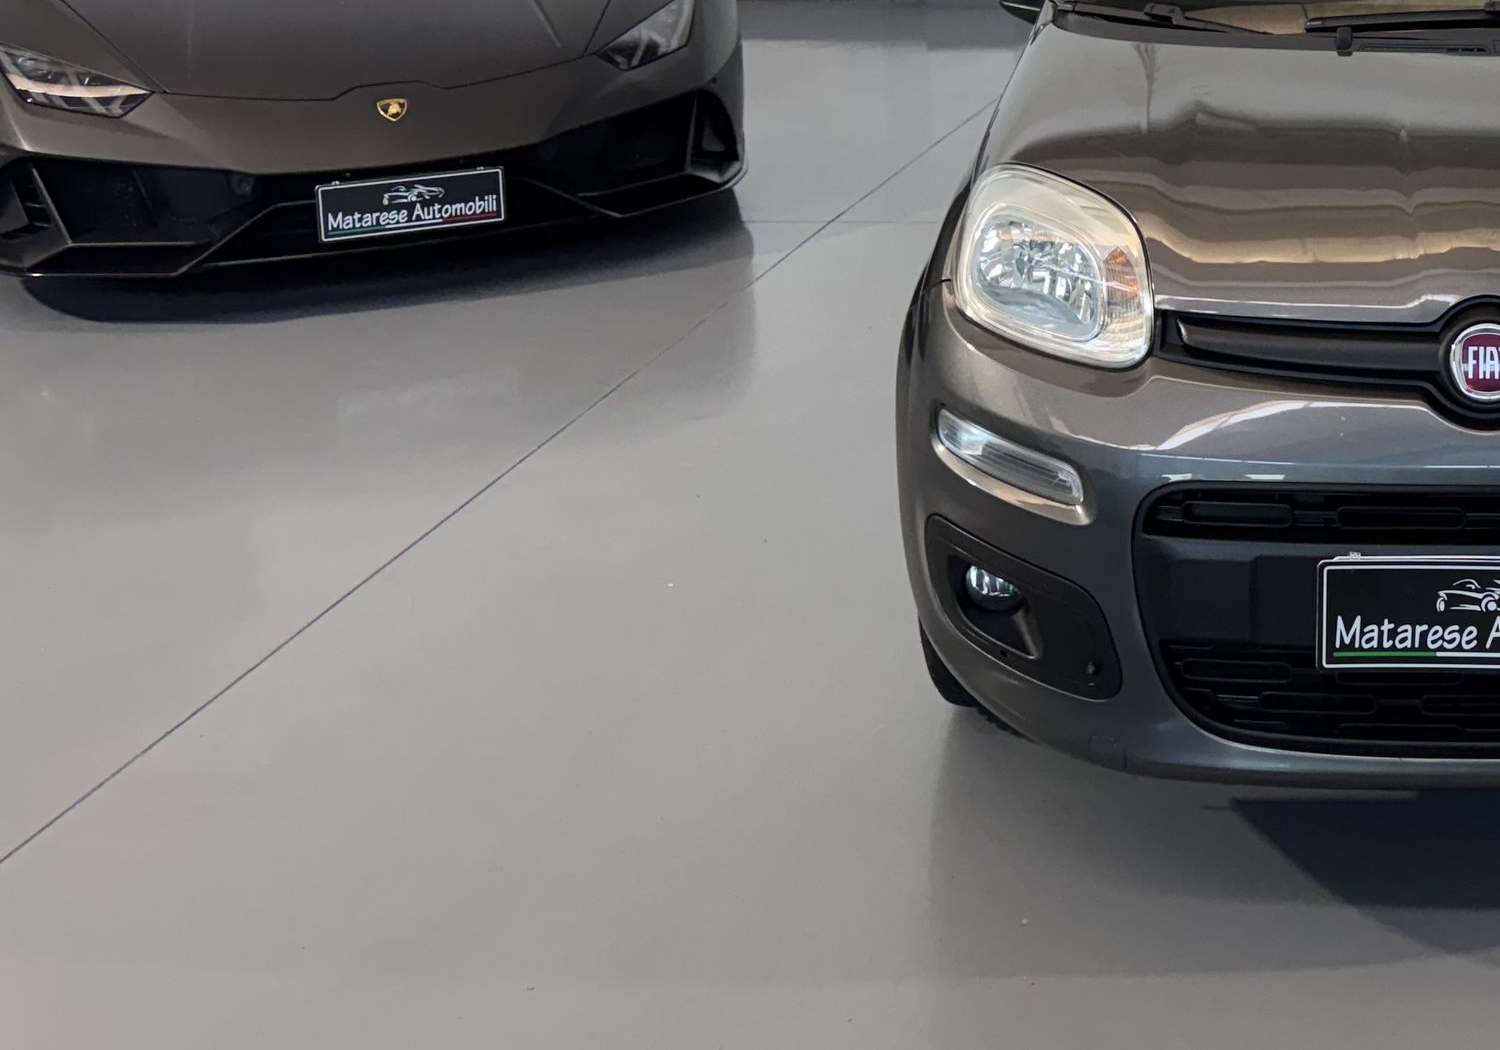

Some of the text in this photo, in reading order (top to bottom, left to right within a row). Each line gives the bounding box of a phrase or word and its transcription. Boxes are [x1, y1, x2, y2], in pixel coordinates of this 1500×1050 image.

[328, 195, 497, 230] Matarese Automobili
[1335, 615, 1478, 649] Matarese
